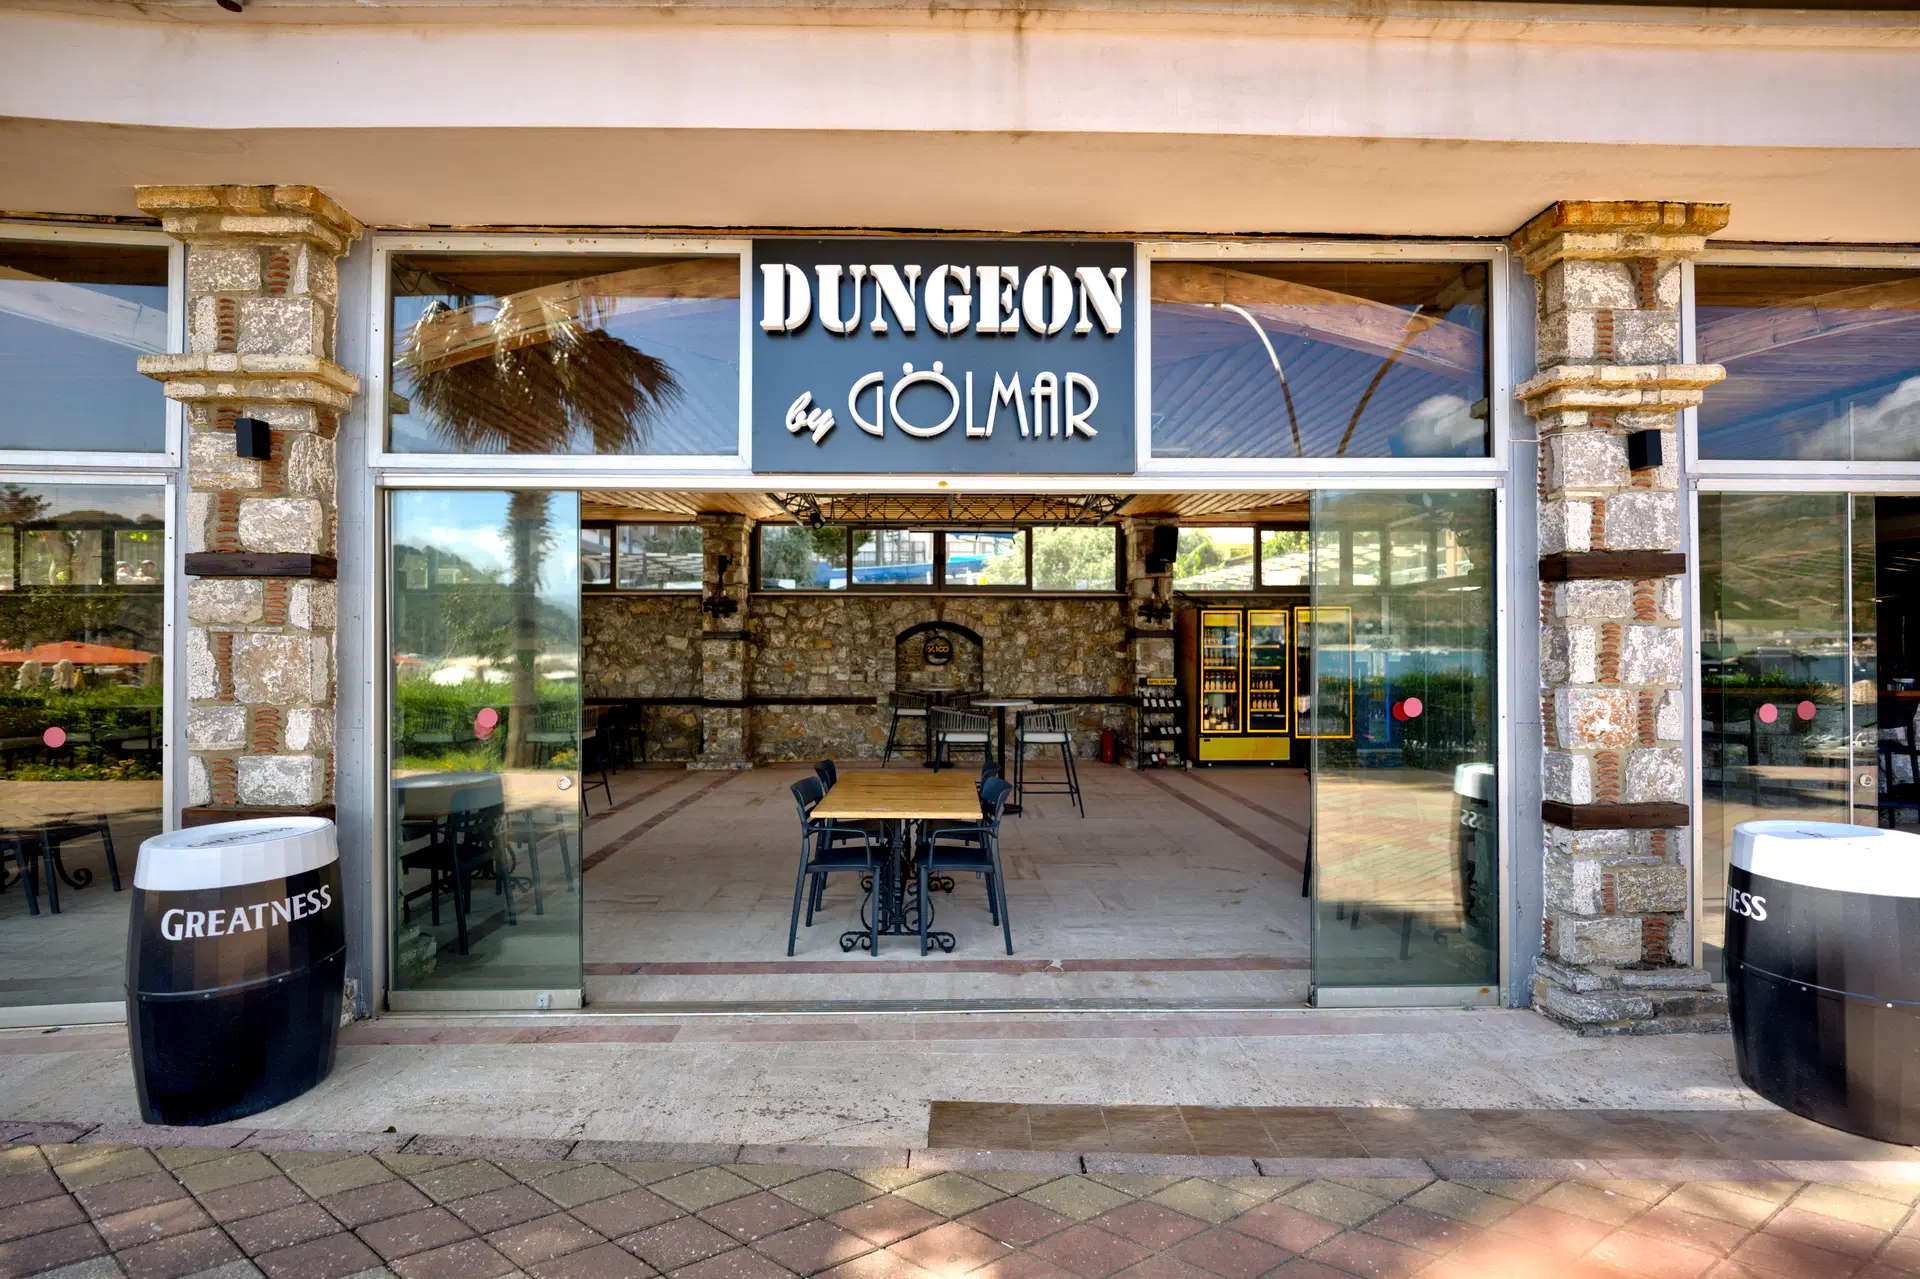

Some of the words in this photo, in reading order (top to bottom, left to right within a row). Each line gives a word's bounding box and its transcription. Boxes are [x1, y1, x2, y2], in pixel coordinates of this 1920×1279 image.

[760, 263, 1128, 334] DUNGEON
[785, 390, 837, 444] by
[848, 360, 1099, 438] GÖLMAR
[160, 884, 332, 941] GREATNESS
